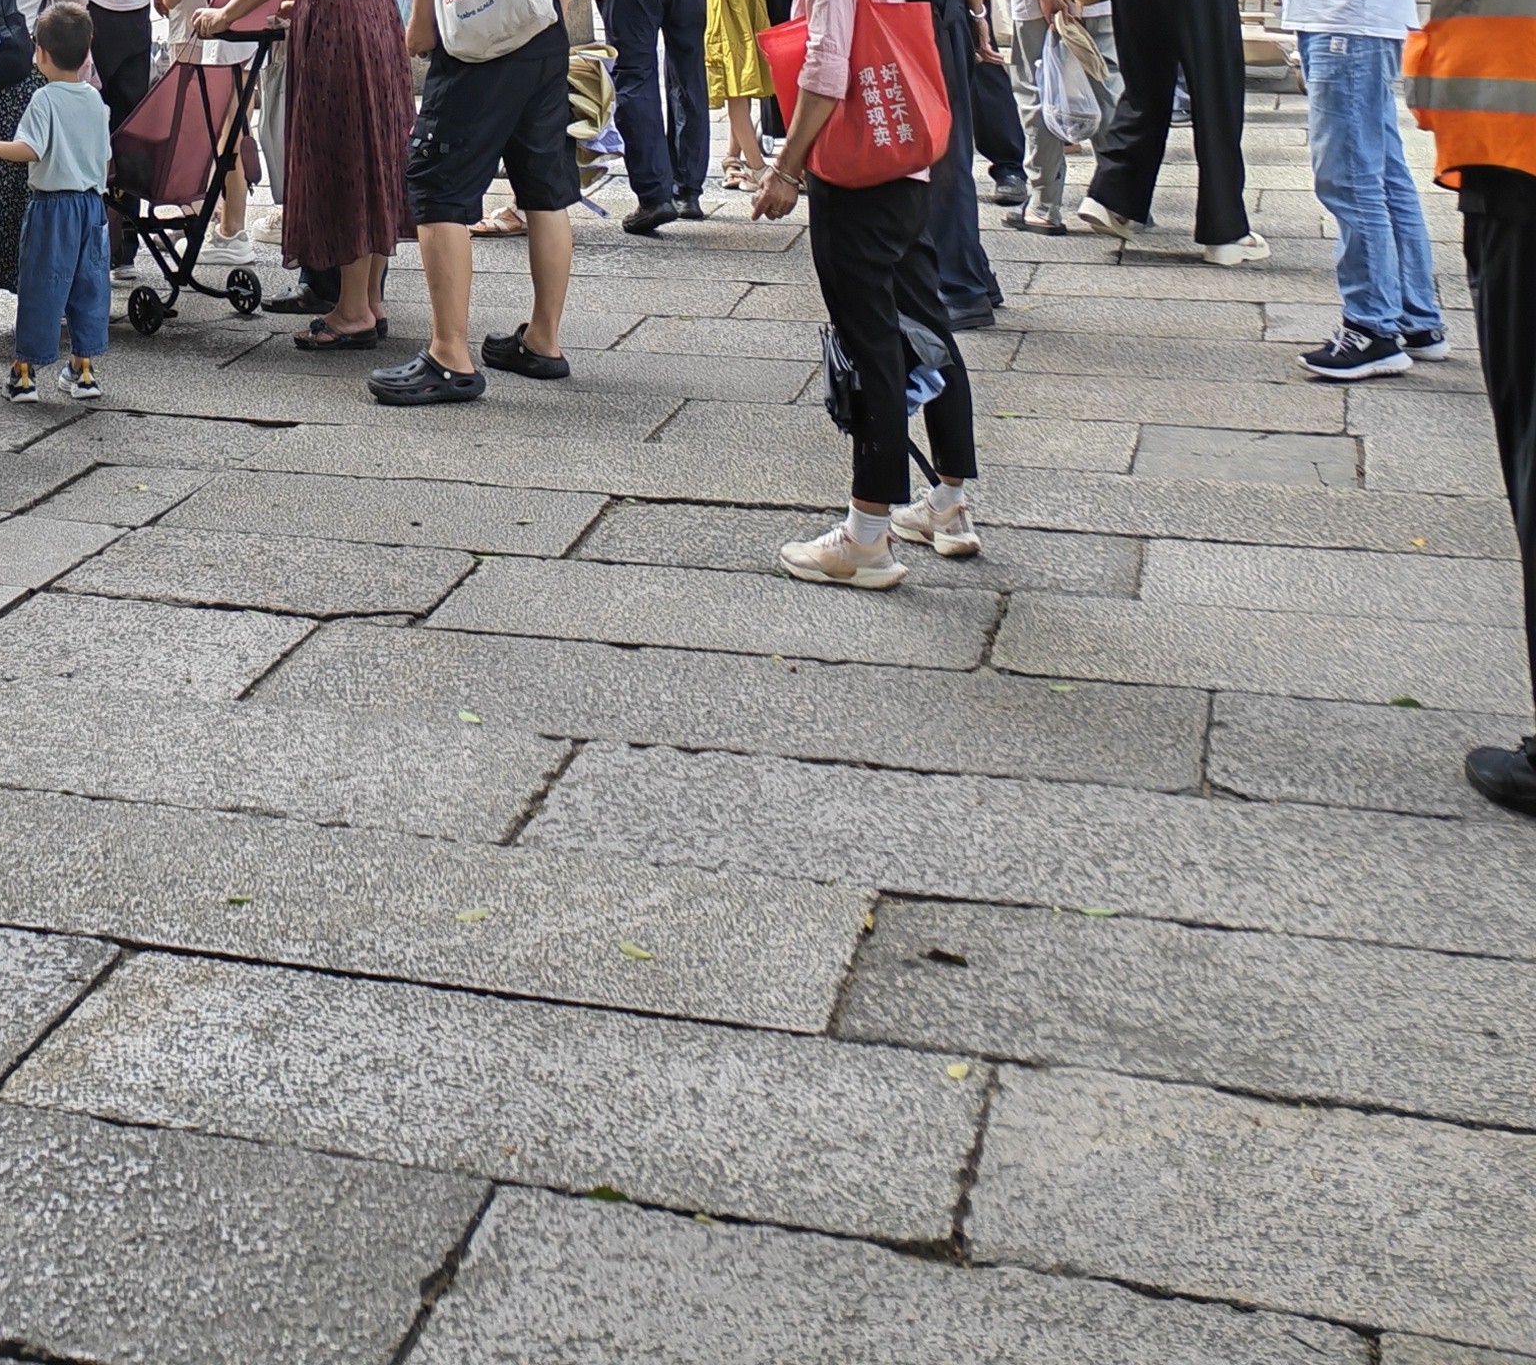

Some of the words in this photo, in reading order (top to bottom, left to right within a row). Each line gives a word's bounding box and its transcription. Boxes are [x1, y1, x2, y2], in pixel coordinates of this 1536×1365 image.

[858, 66, 892, 147] 现做现卖
[880, 62, 914, 144] 好吃不贵
